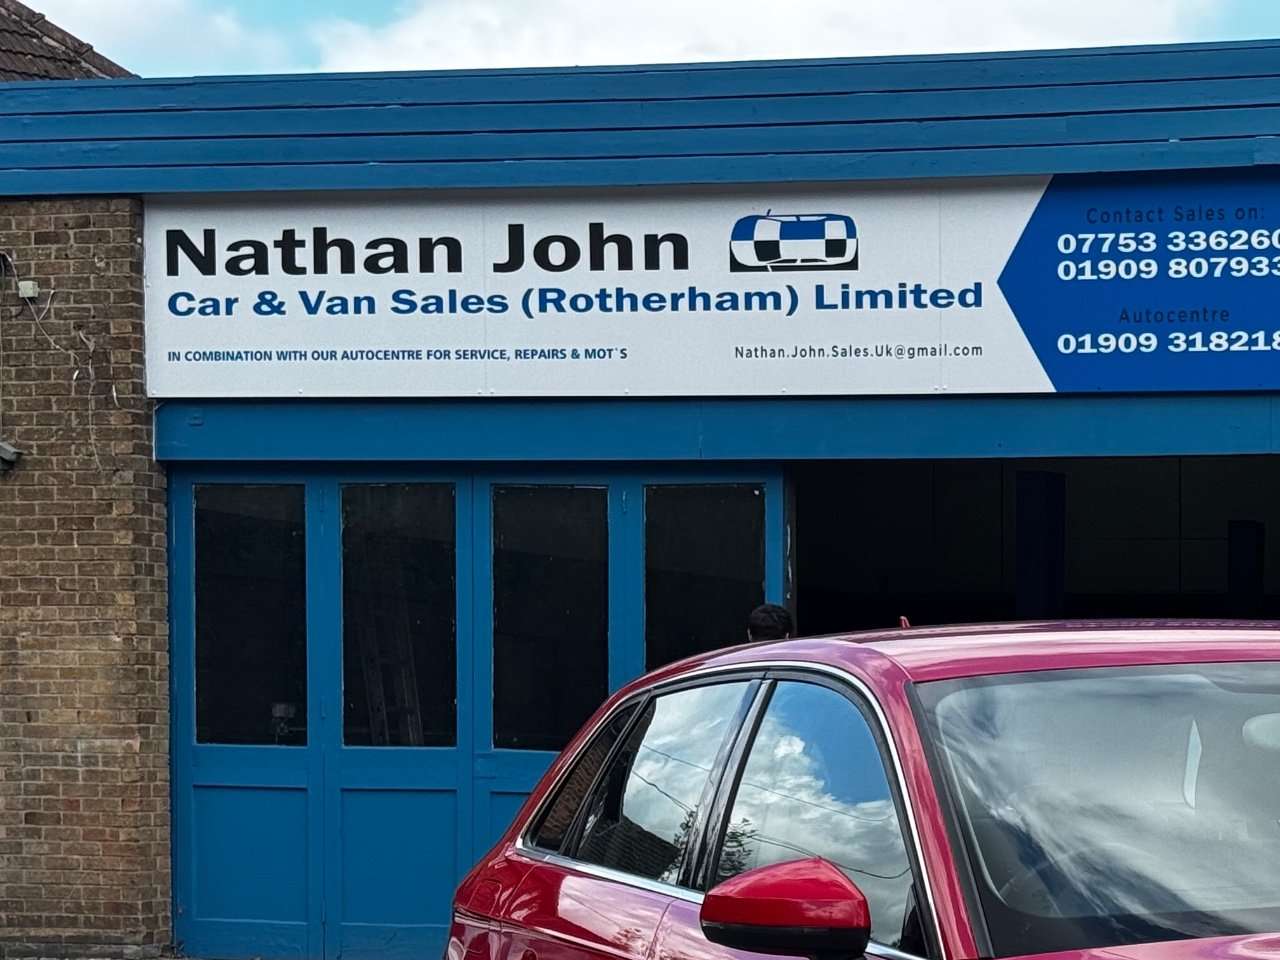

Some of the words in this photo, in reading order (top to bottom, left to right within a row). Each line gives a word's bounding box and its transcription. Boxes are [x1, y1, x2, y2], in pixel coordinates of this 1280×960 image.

[1086, 207, 1164, 224] Contact
[1173, 205, 1225, 222] Sales
[166, 227, 462, 276] Nathan
[493, 223, 688, 272] John
[1058, 232, 1156, 253] 07753
[1058, 259, 1157, 280] 01909
[168, 292, 238, 316] Car
[253, 291, 285, 315] &
[299, 291, 375, 315] Van
[391, 289, 508, 314] Sales
[522, 285, 798, 318] (Rotherham)
[816, 282, 982, 309] Limited
[1119, 307, 1230, 324] Autocentre
[736, 344, 982, 359] Nathan.John.Sales.Uk@gmail.com
[1058, 333, 1157, 353] 01909
[168, 352, 180, 361] IN
[185, 351, 272, 361] COMBINATION
[276, 351, 307, 360] WITH
[312, 351, 337, 360] OUR
[341, 350, 422, 360] AUTOCENTRE
[427, 350, 450, 360] FOR
[455, 350, 510, 360] SERVICE,
[515, 349, 566, 359] REPAIRS
[571, 349, 580, 359] &
